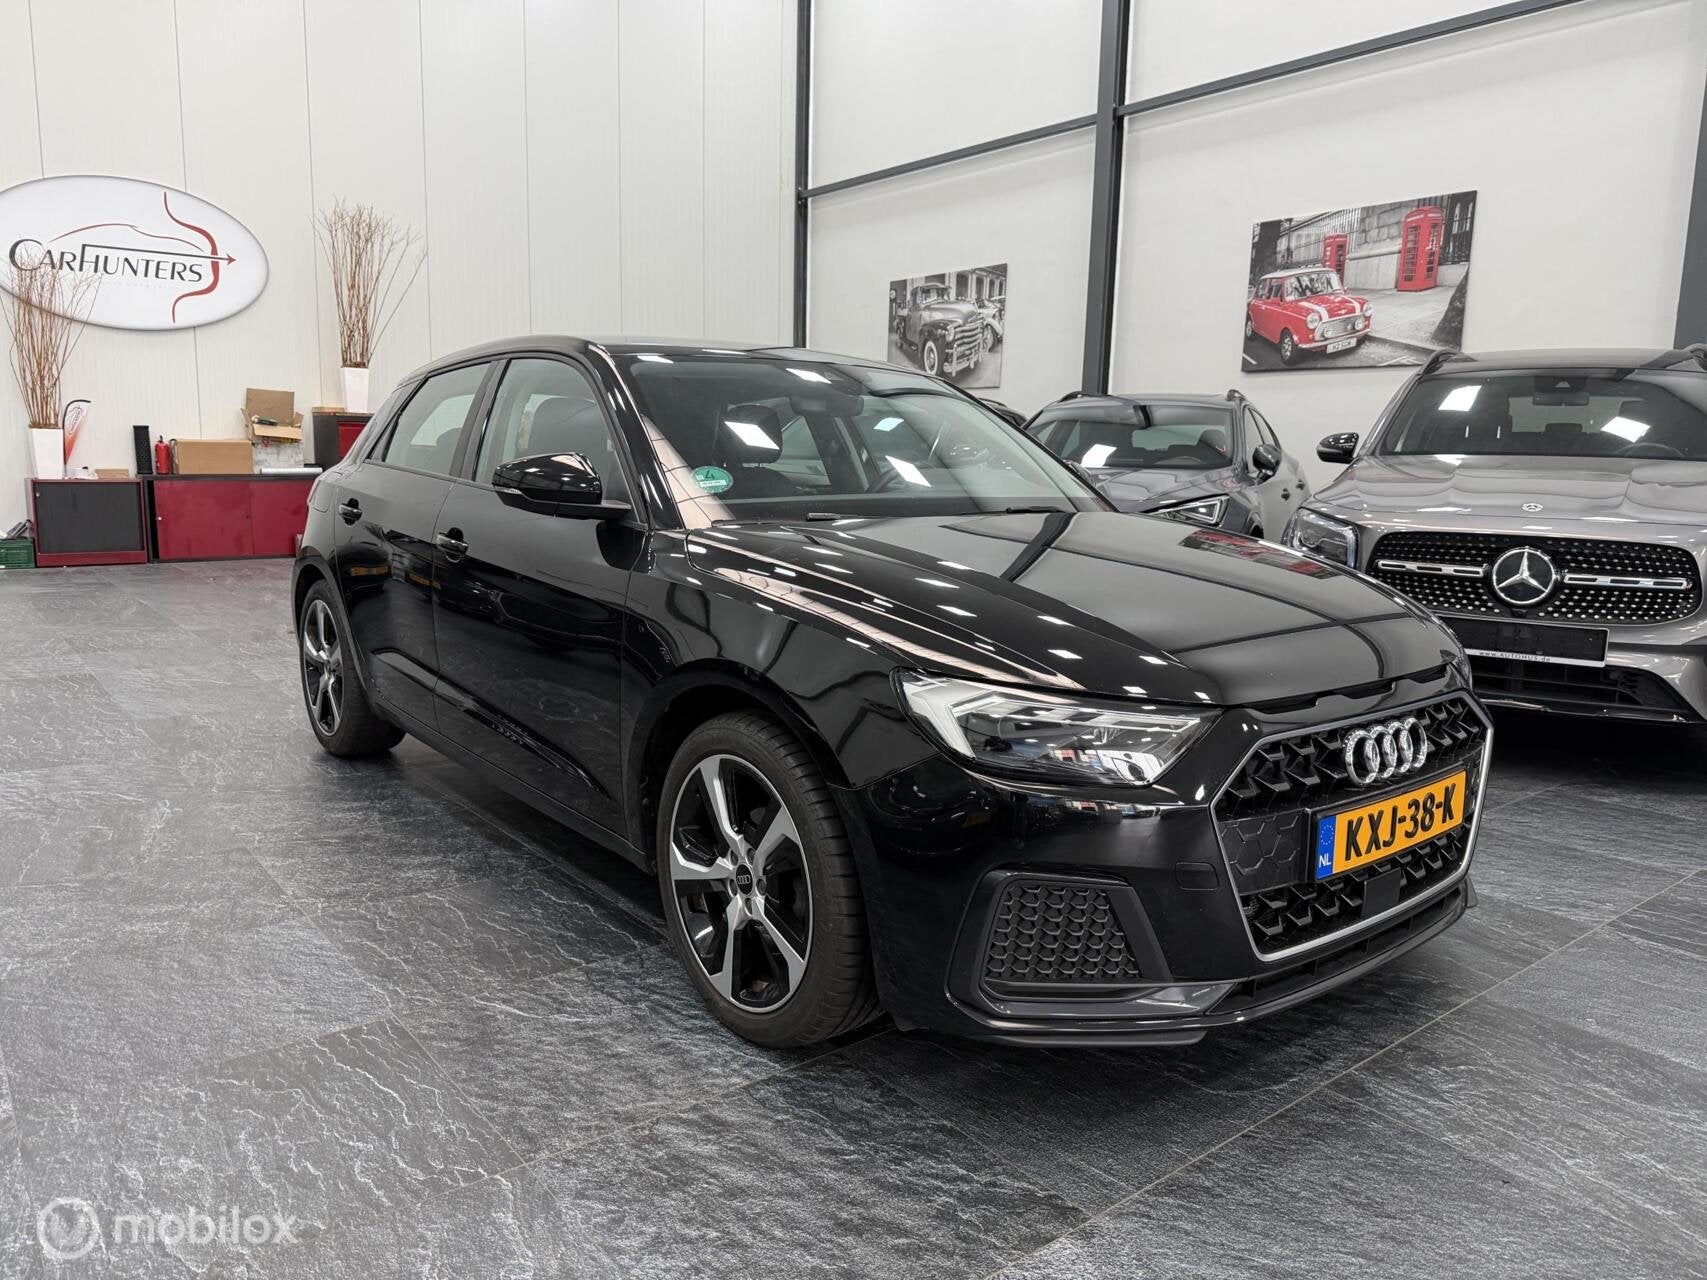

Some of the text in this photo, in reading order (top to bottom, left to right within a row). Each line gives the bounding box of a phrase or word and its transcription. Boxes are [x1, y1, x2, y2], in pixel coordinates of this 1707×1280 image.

[9, 238, 203, 283] CARHUNTERS
[1344, 782, 1456, 861] KXJ-38-K
[1318, 852, 1332, 868] NL
